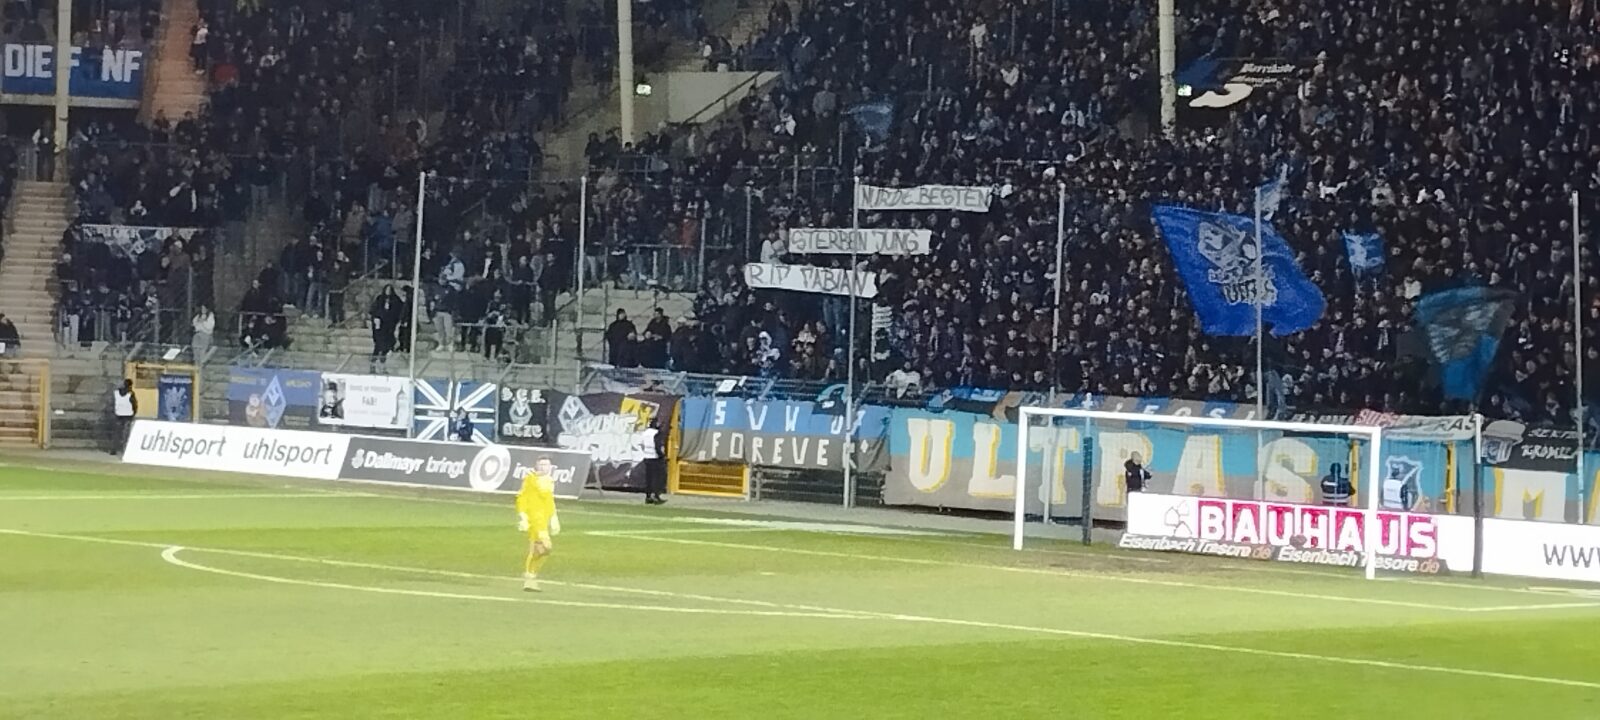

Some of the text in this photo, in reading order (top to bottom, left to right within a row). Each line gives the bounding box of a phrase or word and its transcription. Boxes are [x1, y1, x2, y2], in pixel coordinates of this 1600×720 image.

[4, 43, 142, 83] DIE FNF
[918, 187, 989, 208] BESTEN
[791, 230, 919, 251] STERBEN JUNG
[749, 264, 868, 296] RIP FABIAN
[714, 400, 800, 432] SVW
[140, 430, 227, 459] uhlsport
[243, 438, 333, 466] uhlsport
[711, 431, 857, 469] FOREVER
[363, 450, 425, 474] Dallmayr
[426, 456, 467, 478] bringt
[907, 417, 1318, 507] ULTRAS
[1119, 533, 1194, 551] Eisenbach
[1200, 504, 1437, 558] BAUHAUS
[1278, 546, 1440, 574] Eisenbach Tesore.de
[1543, 543, 1600, 568] ww
